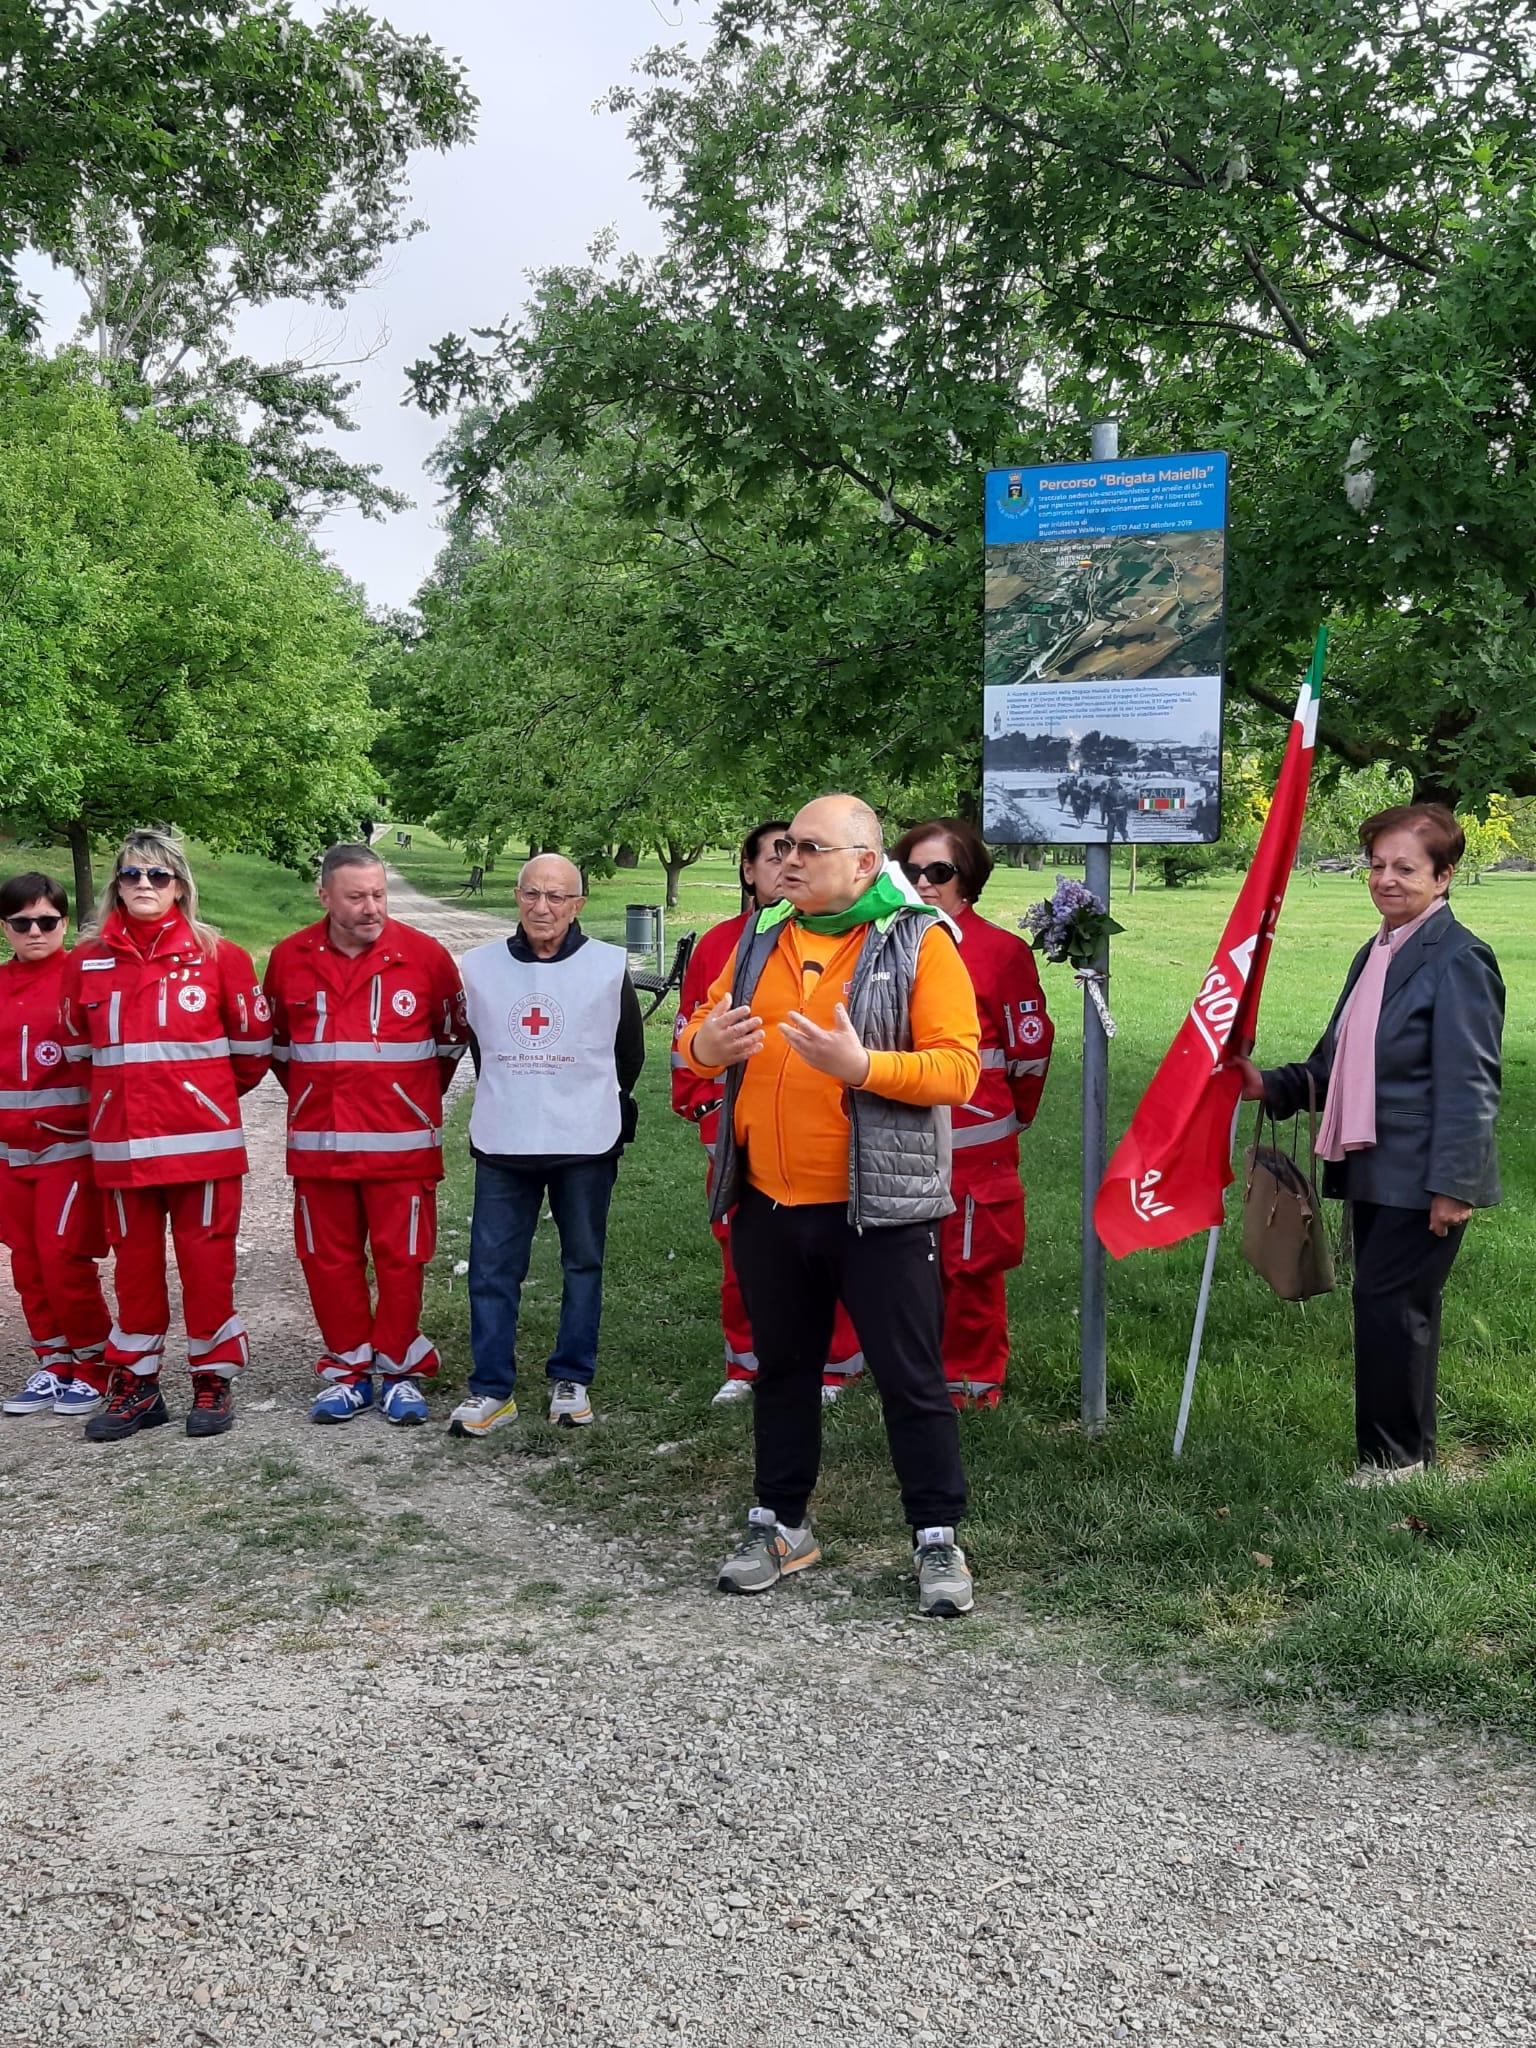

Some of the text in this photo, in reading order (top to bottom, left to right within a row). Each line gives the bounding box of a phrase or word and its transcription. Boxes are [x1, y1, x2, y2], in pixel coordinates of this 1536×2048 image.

[1039, 478, 1097, 491] Percorso
[518, 1053, 544, 1062] Rossa
[546, 1053, 576, 1063] Italiana
